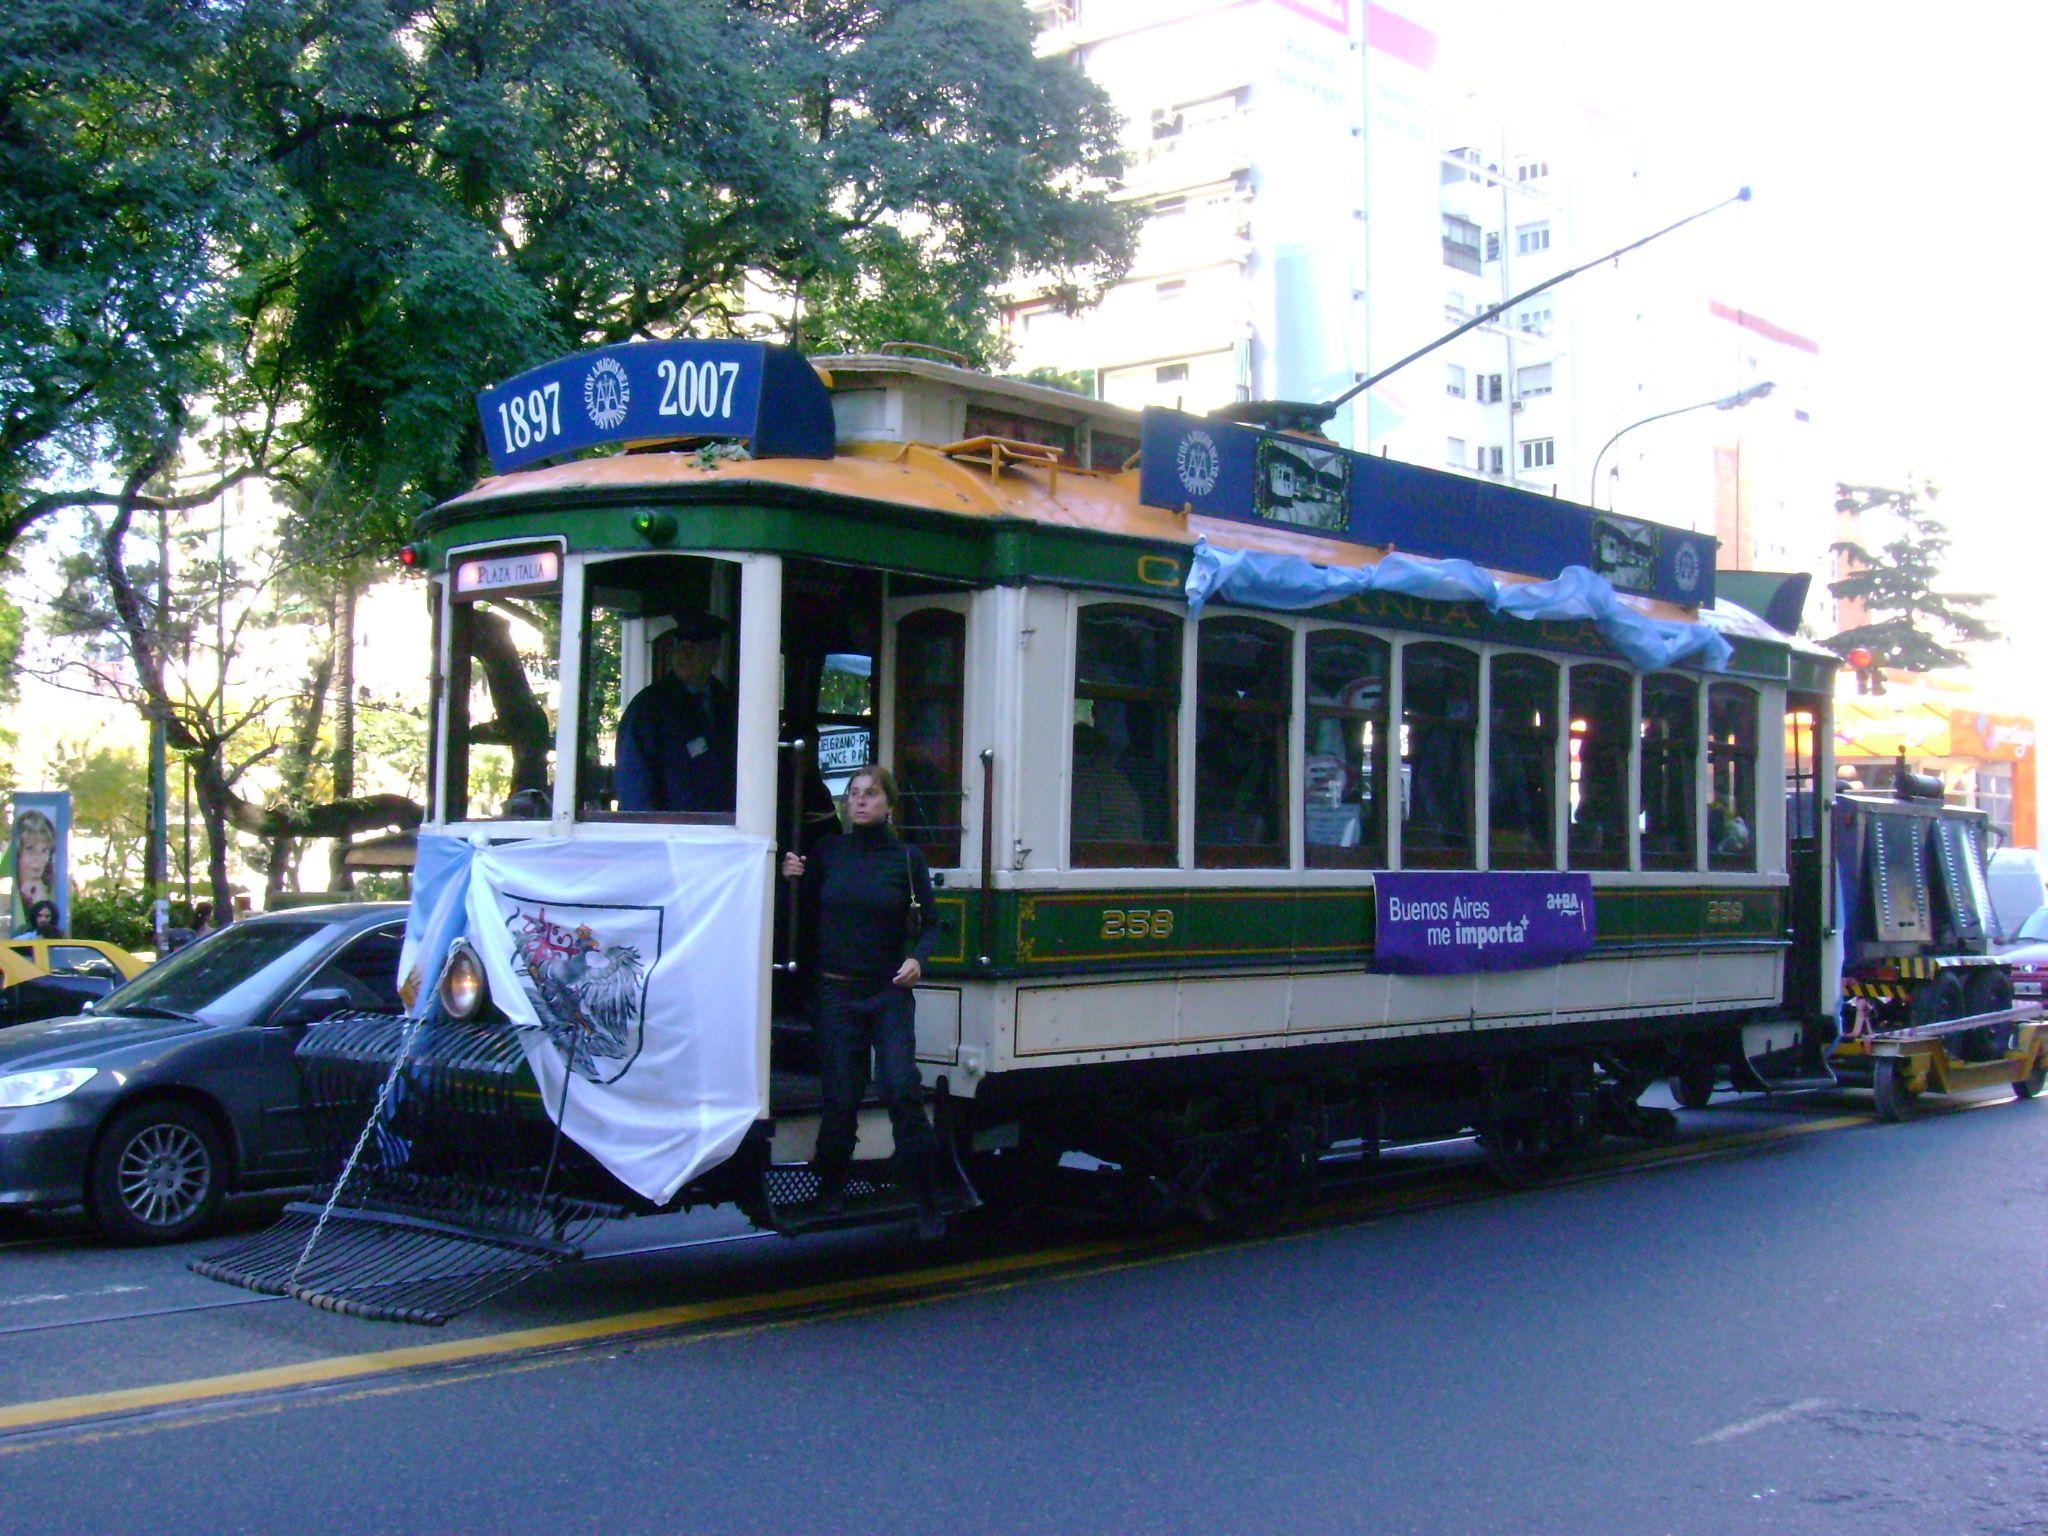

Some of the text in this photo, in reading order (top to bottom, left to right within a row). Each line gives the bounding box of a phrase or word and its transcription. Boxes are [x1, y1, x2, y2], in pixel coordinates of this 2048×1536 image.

[657, 359, 740, 418] 2007
[498, 382, 561, 454] 1897
[514, 562, 545, 581] ITALIA
[1389, 896, 1490, 922] Buenos Aires
[1100, 908, 1175, 940] 258
[1427, 925, 1451, 946] me
